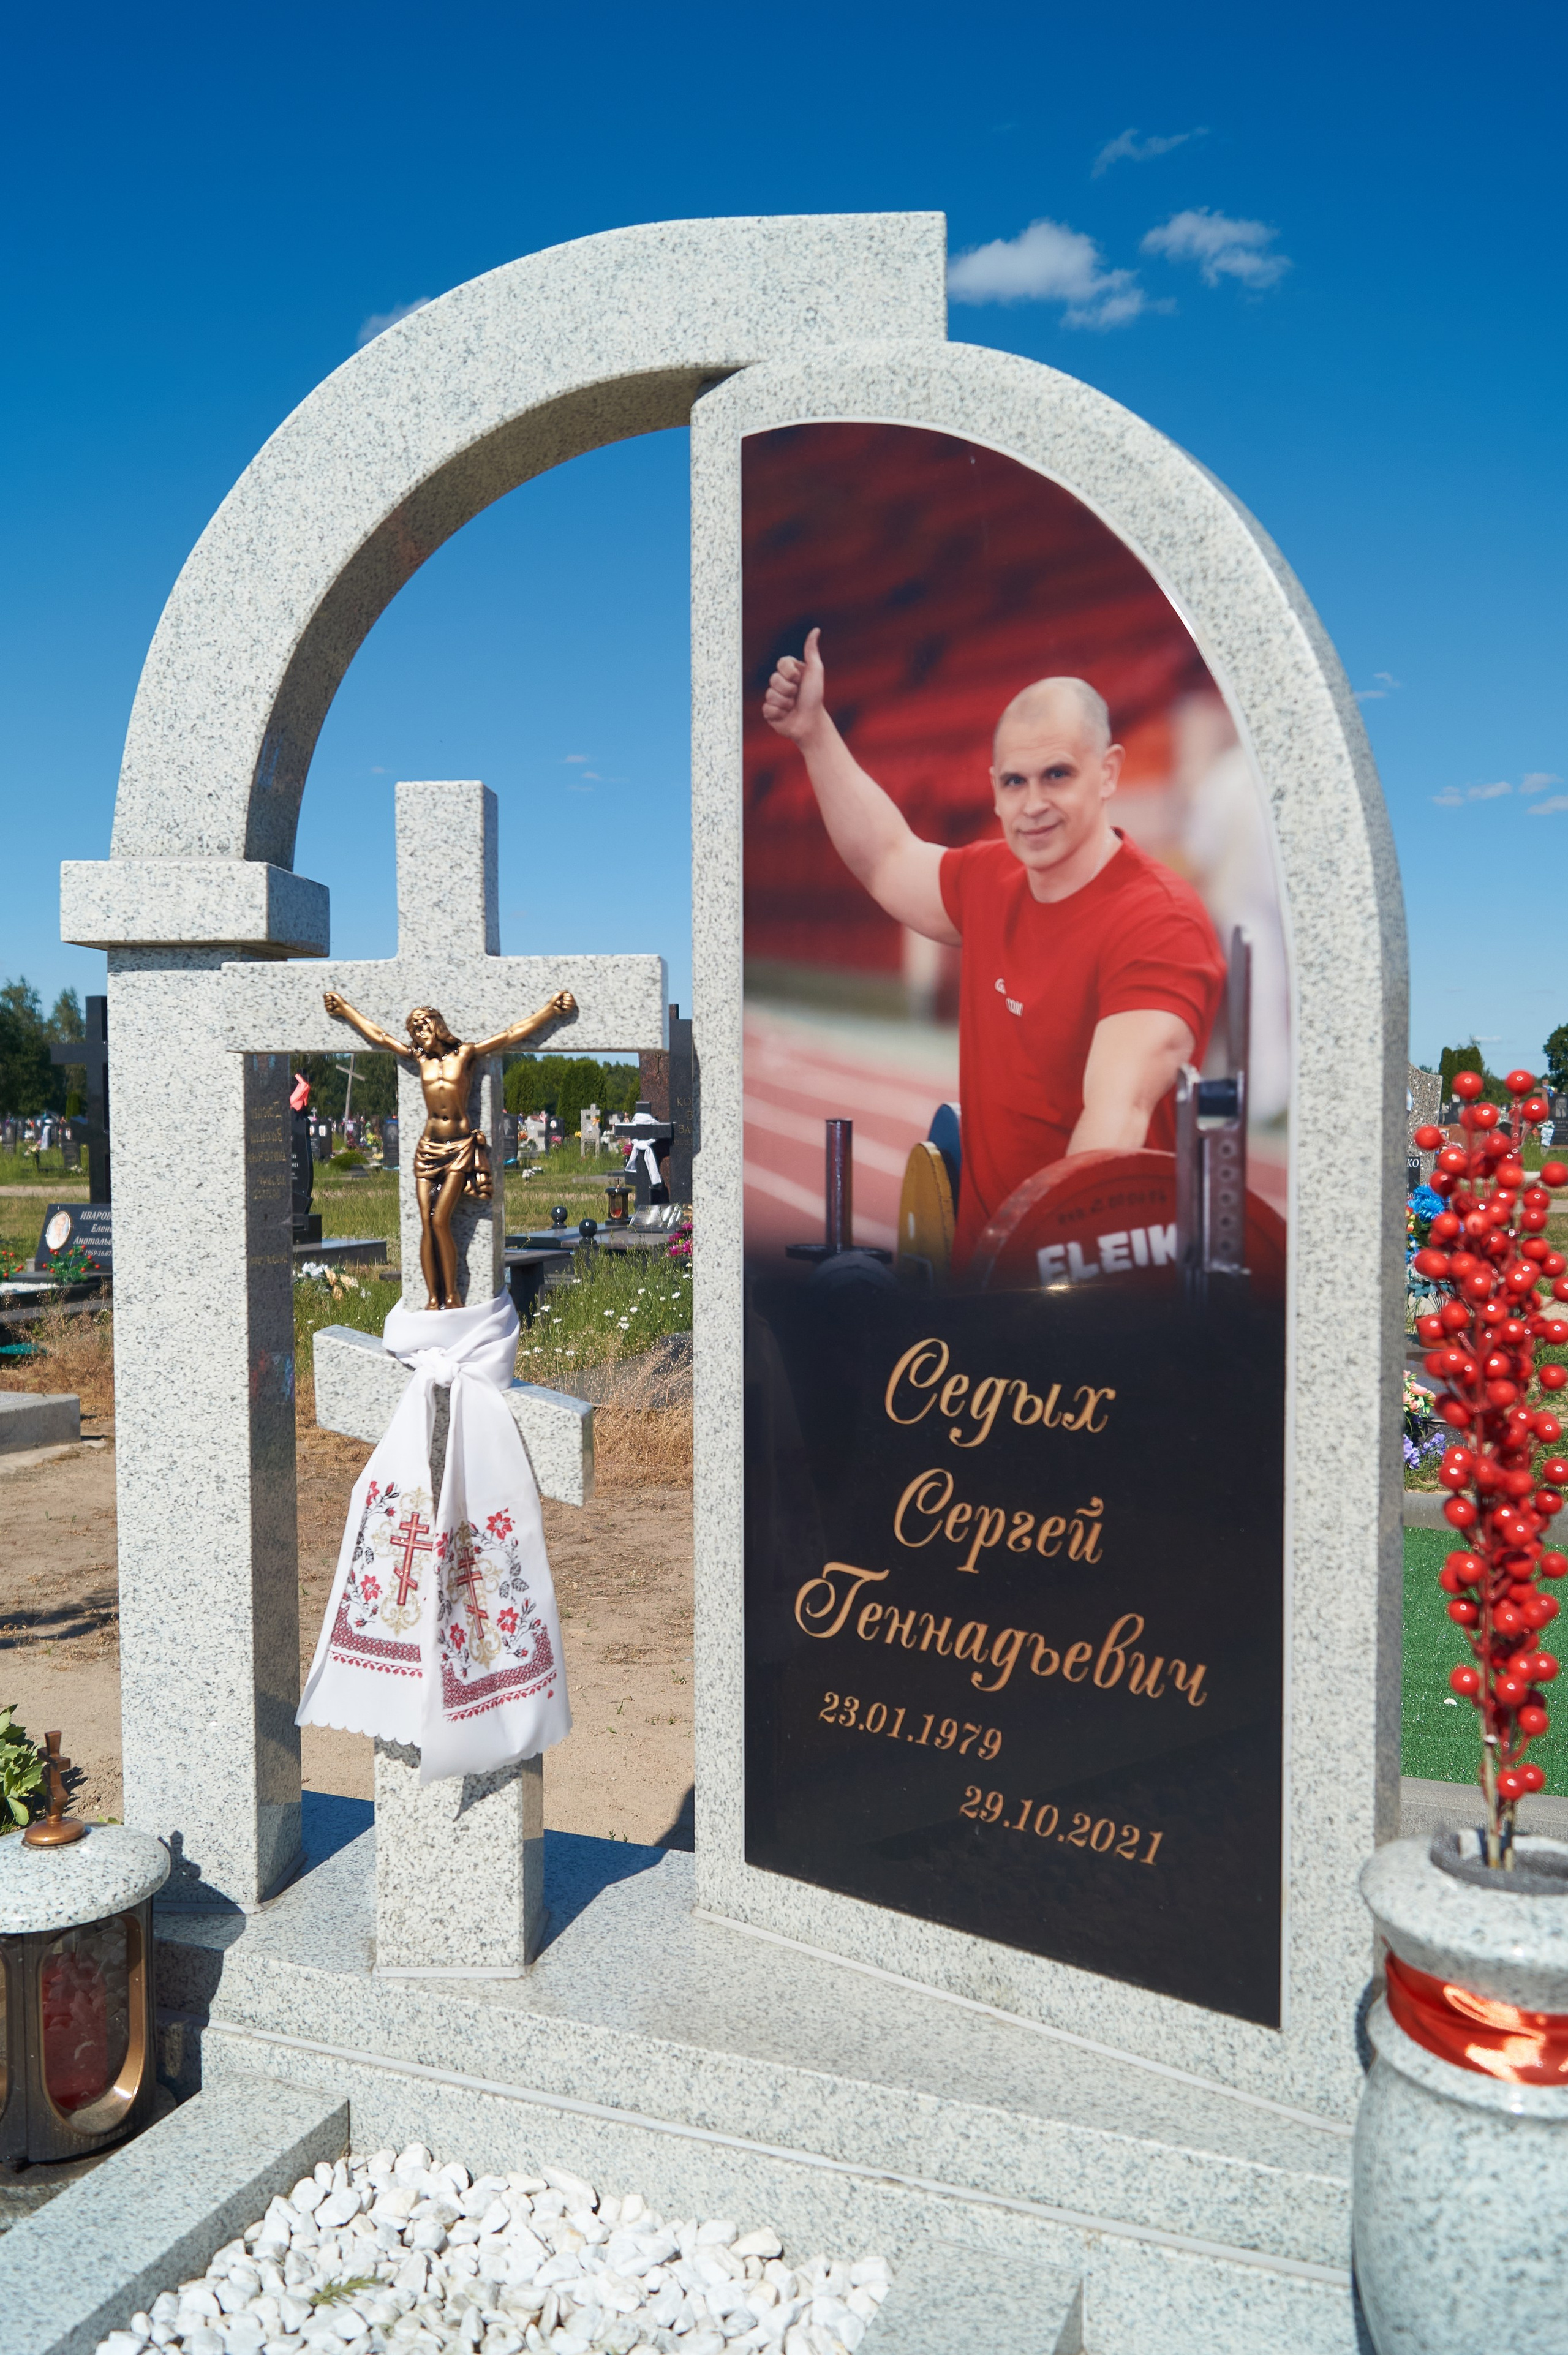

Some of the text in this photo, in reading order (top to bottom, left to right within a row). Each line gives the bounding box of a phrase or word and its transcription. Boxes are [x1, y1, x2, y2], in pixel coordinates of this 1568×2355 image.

[885, 1338, 1116, 1448] Седых
[894, 1469, 1104, 1573] Сергей
[795, 1562, 1207, 1707] Геннадьевич
[819, 1692, 1003, 1760] 23.01.1979
[960, 1786, 1163, 1866] 29.10.2021
